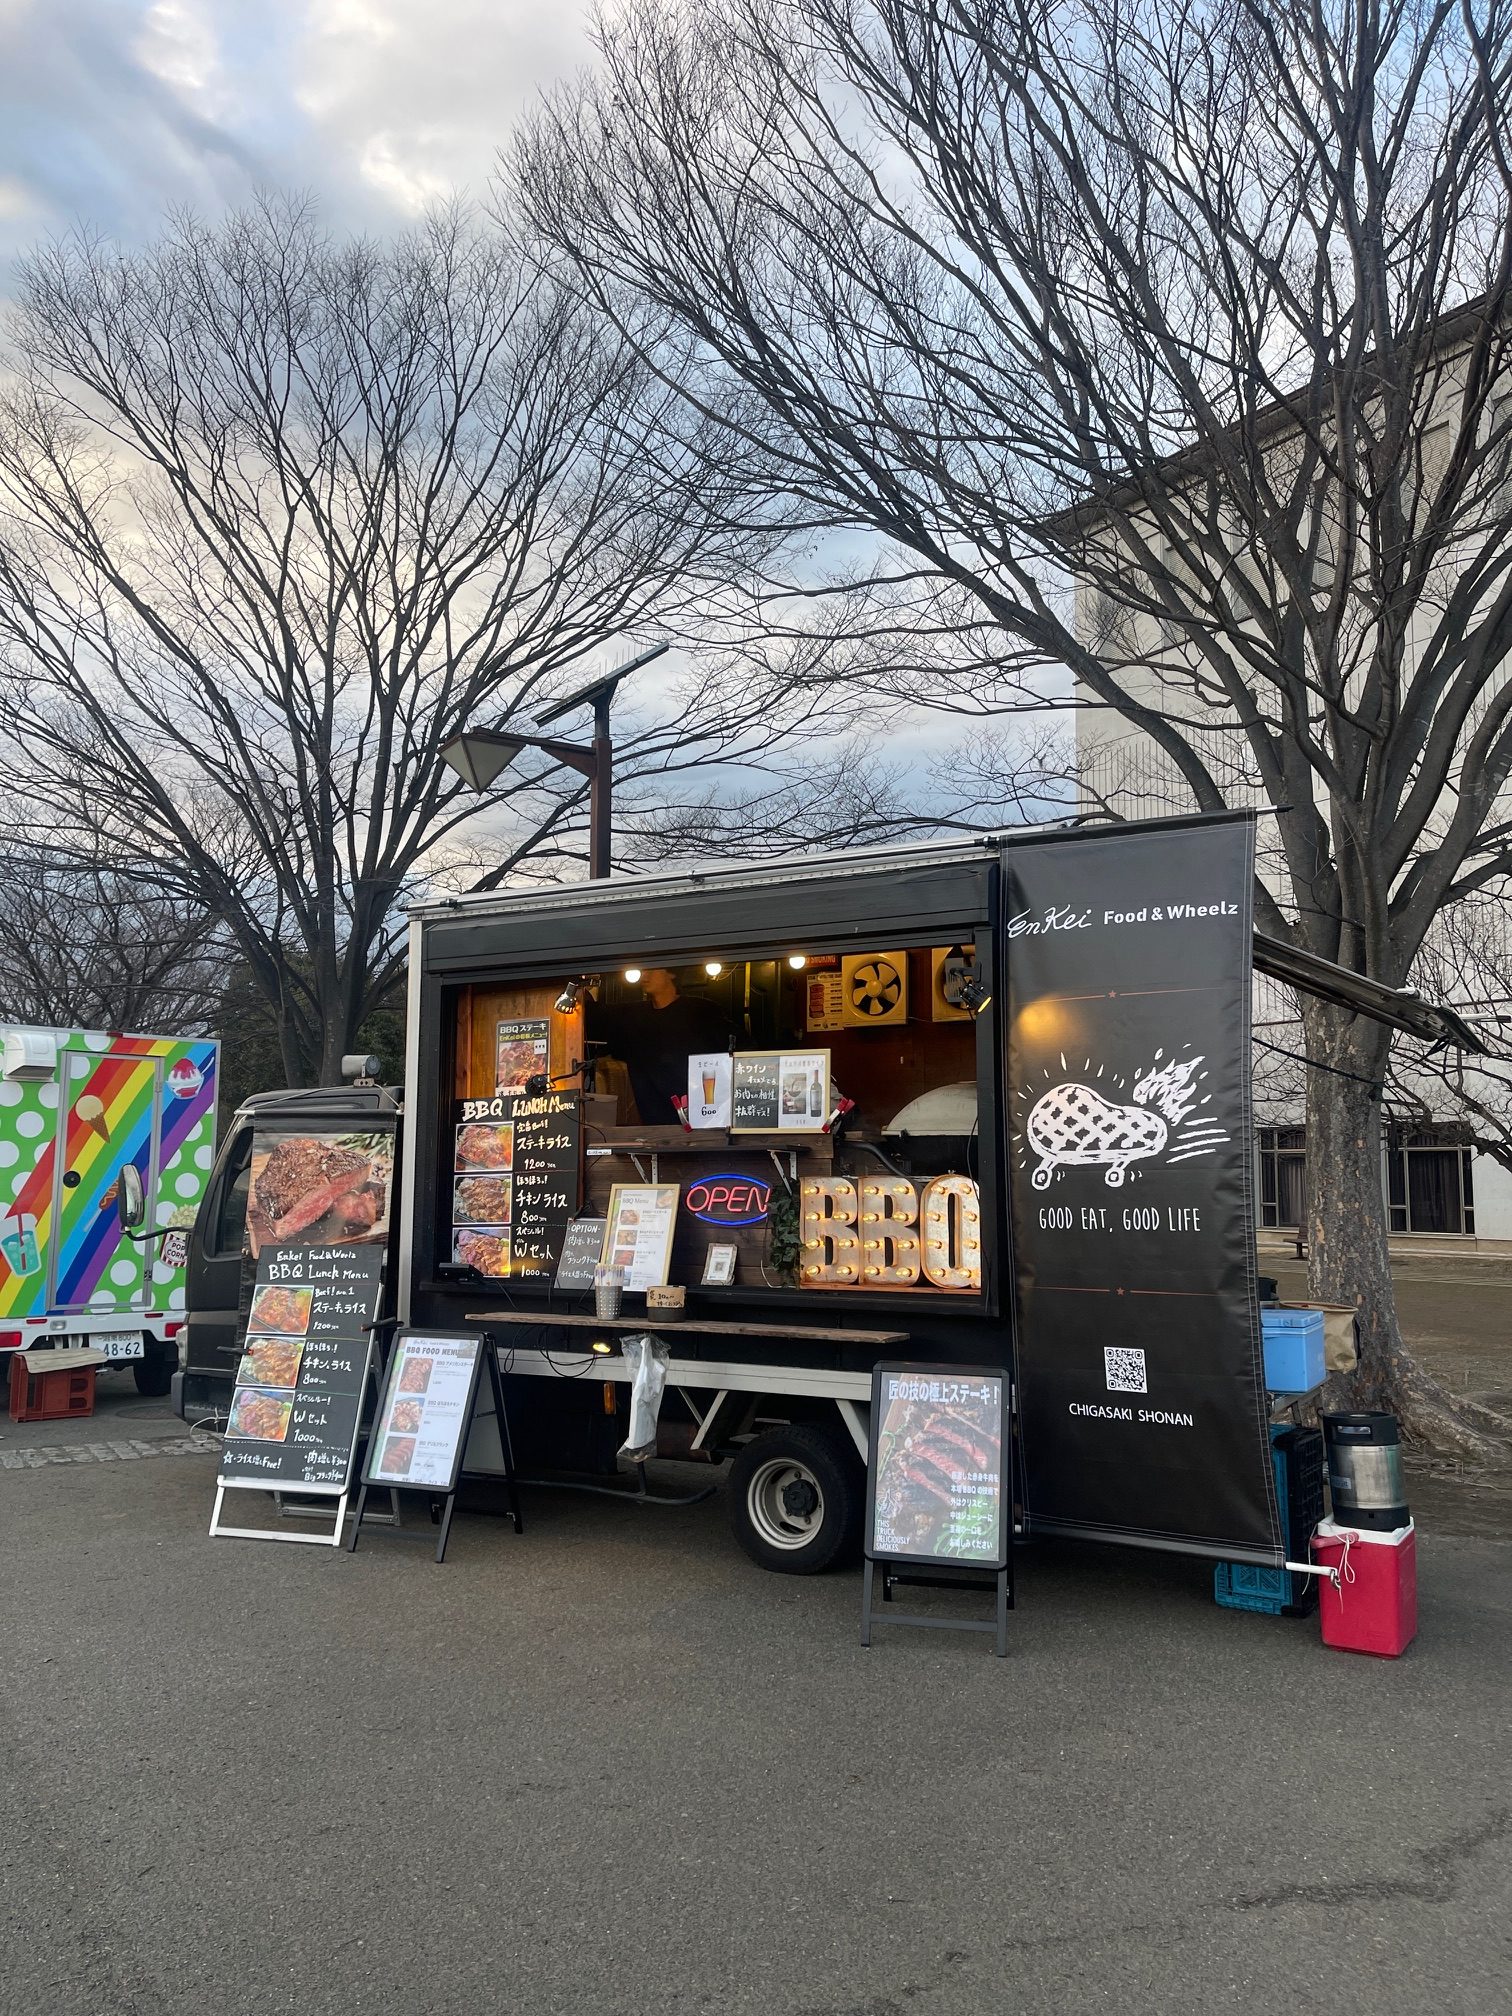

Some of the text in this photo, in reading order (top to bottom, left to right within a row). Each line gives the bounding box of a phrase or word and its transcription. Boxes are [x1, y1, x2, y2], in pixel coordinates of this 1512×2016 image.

[1007, 901, 1238, 938] EnKei Food & Wheelz
[500, 1023, 547, 1034] BBQ ステーキ
[462, 1099, 503, 1121] BBQ
[701, 1106, 717, 1116] 600
[686, 1185, 770, 1214] OPEN
[1039, 1206, 1200, 1233] GOOD EAT, GOOD LIFE
[167, 1249, 186, 1259] CORN
[171, 1243, 185, 1251] POP
[268, 1264, 369, 1280] BBQ Lunch Menu
[406, 1346, 420, 1354] BBQ
[422, 1347, 440, 1355] FOOD
[888, 1379, 999, 1405] 匠の技の極上ステーキ!
[1068, 1403, 1194, 1427] CHIGASAKI SHONAN
